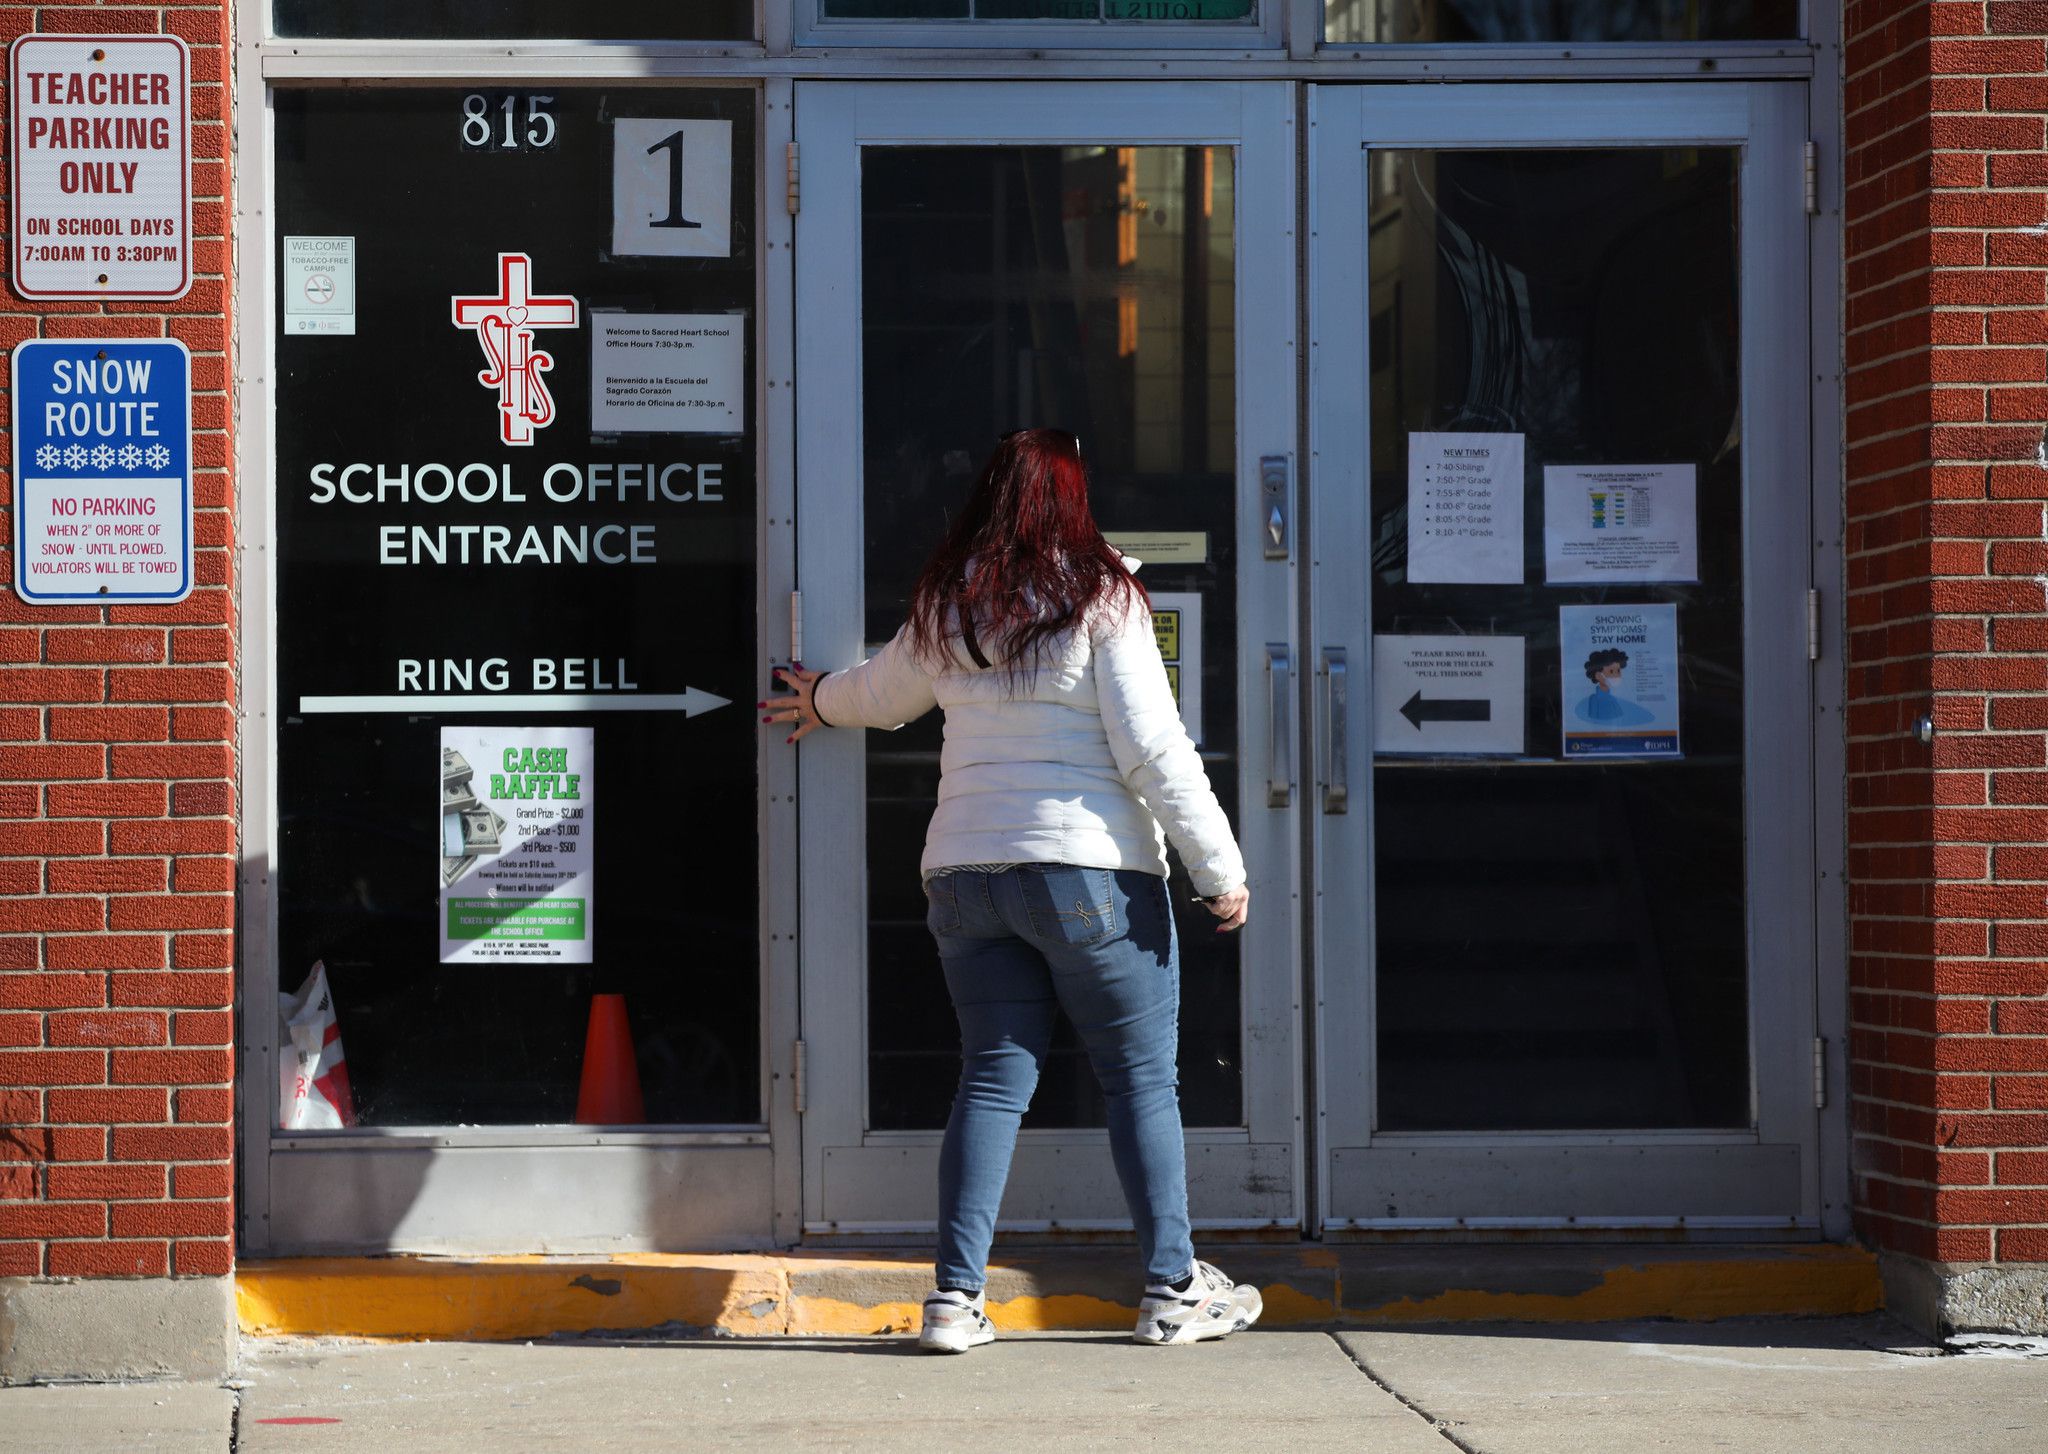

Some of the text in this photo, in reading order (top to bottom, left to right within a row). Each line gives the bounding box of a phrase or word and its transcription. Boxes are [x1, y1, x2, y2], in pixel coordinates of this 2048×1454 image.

[27, 73, 170, 105] TEACHER
[463, 95, 556, 147] 815
[28, 117, 170, 150] PARKING
[60, 161, 139, 194] ONLY
[647, 130, 702, 229] 1
[27, 218, 174, 236] ON SCHOOL DAYS
[292, 241, 348, 251] WELCOME
[25, 246, 177, 262] 7:00AM TO 3:30PM
[606, 328, 730, 336] Welcome to Sacred Heart School
[655, 341, 695, 349] 7:30-3p.m.
[52, 359, 152, 395] SNOW
[606, 377, 648, 385] Bienvenido
[656, 377, 663, 385] la
[664, 377, 695, 385] Escuela
[696, 377, 708, 385] del
[606, 387, 672, 396] Sagrado Corazón
[606, 400, 635, 408] Horario
[636, 400, 646, 408] de
[647, 400, 675, 408] Oficina
[676, 400, 686, 408] de
[45, 402, 159, 437] ROUTE
[1444, 449, 1490, 457] NEW TIMES
[309, 463, 724, 503] SCHOOL OFFICE
[1467, 476, 1492, 484] Grade
[1467, 489, 1492, 497] Grade
[52, 497, 156, 516] NO PARKING
[1467, 502, 1492, 510] Grade
[1467, 515, 1492, 523] Grade
[47, 525, 78, 536] WHEN
[95, 525, 111, 536] OR
[114, 525, 144, 536] MORE
[148, 525, 162, 536] OF
[1469, 528, 1493, 537] Grade
[41, 543, 74, 555] SNOW
[86, 543, 117, 555] UNTIL
[120, 543, 167, 555] PLOWED.
[379, 525, 657, 565] ENTRANCE
[32, 562, 177, 574] VIOLATORS WILL BE TOWED
[1595, 615, 1642, 624] SHOWING
[1591, 625, 1647, 634] SYMPTOMS?
[1592, 635, 1646, 644] STAY HOME
[398, 658, 638, 691] RING BELL
[503, 747, 568, 773] CASH
[490, 774, 581, 800] RAFFLE
[517, 808, 537, 819] Grand
[538, 808, 554, 819] Prize
[518, 825, 531, 835] 2nd
[532, 825, 551, 835] Place
[522, 842, 533, 852] 3rd
[534, 842, 552, 852] Place
[559, 842, 576, 852] $500
[498, 860, 517, 868] Tickets
[518, 860, 528, 868] are
[496, 884, 516, 892] Winners
[518, 884, 527, 892] will
[528, 884, 534, 892] be
[491, 928, 544, 936] THE SCHOOL OFFICE
